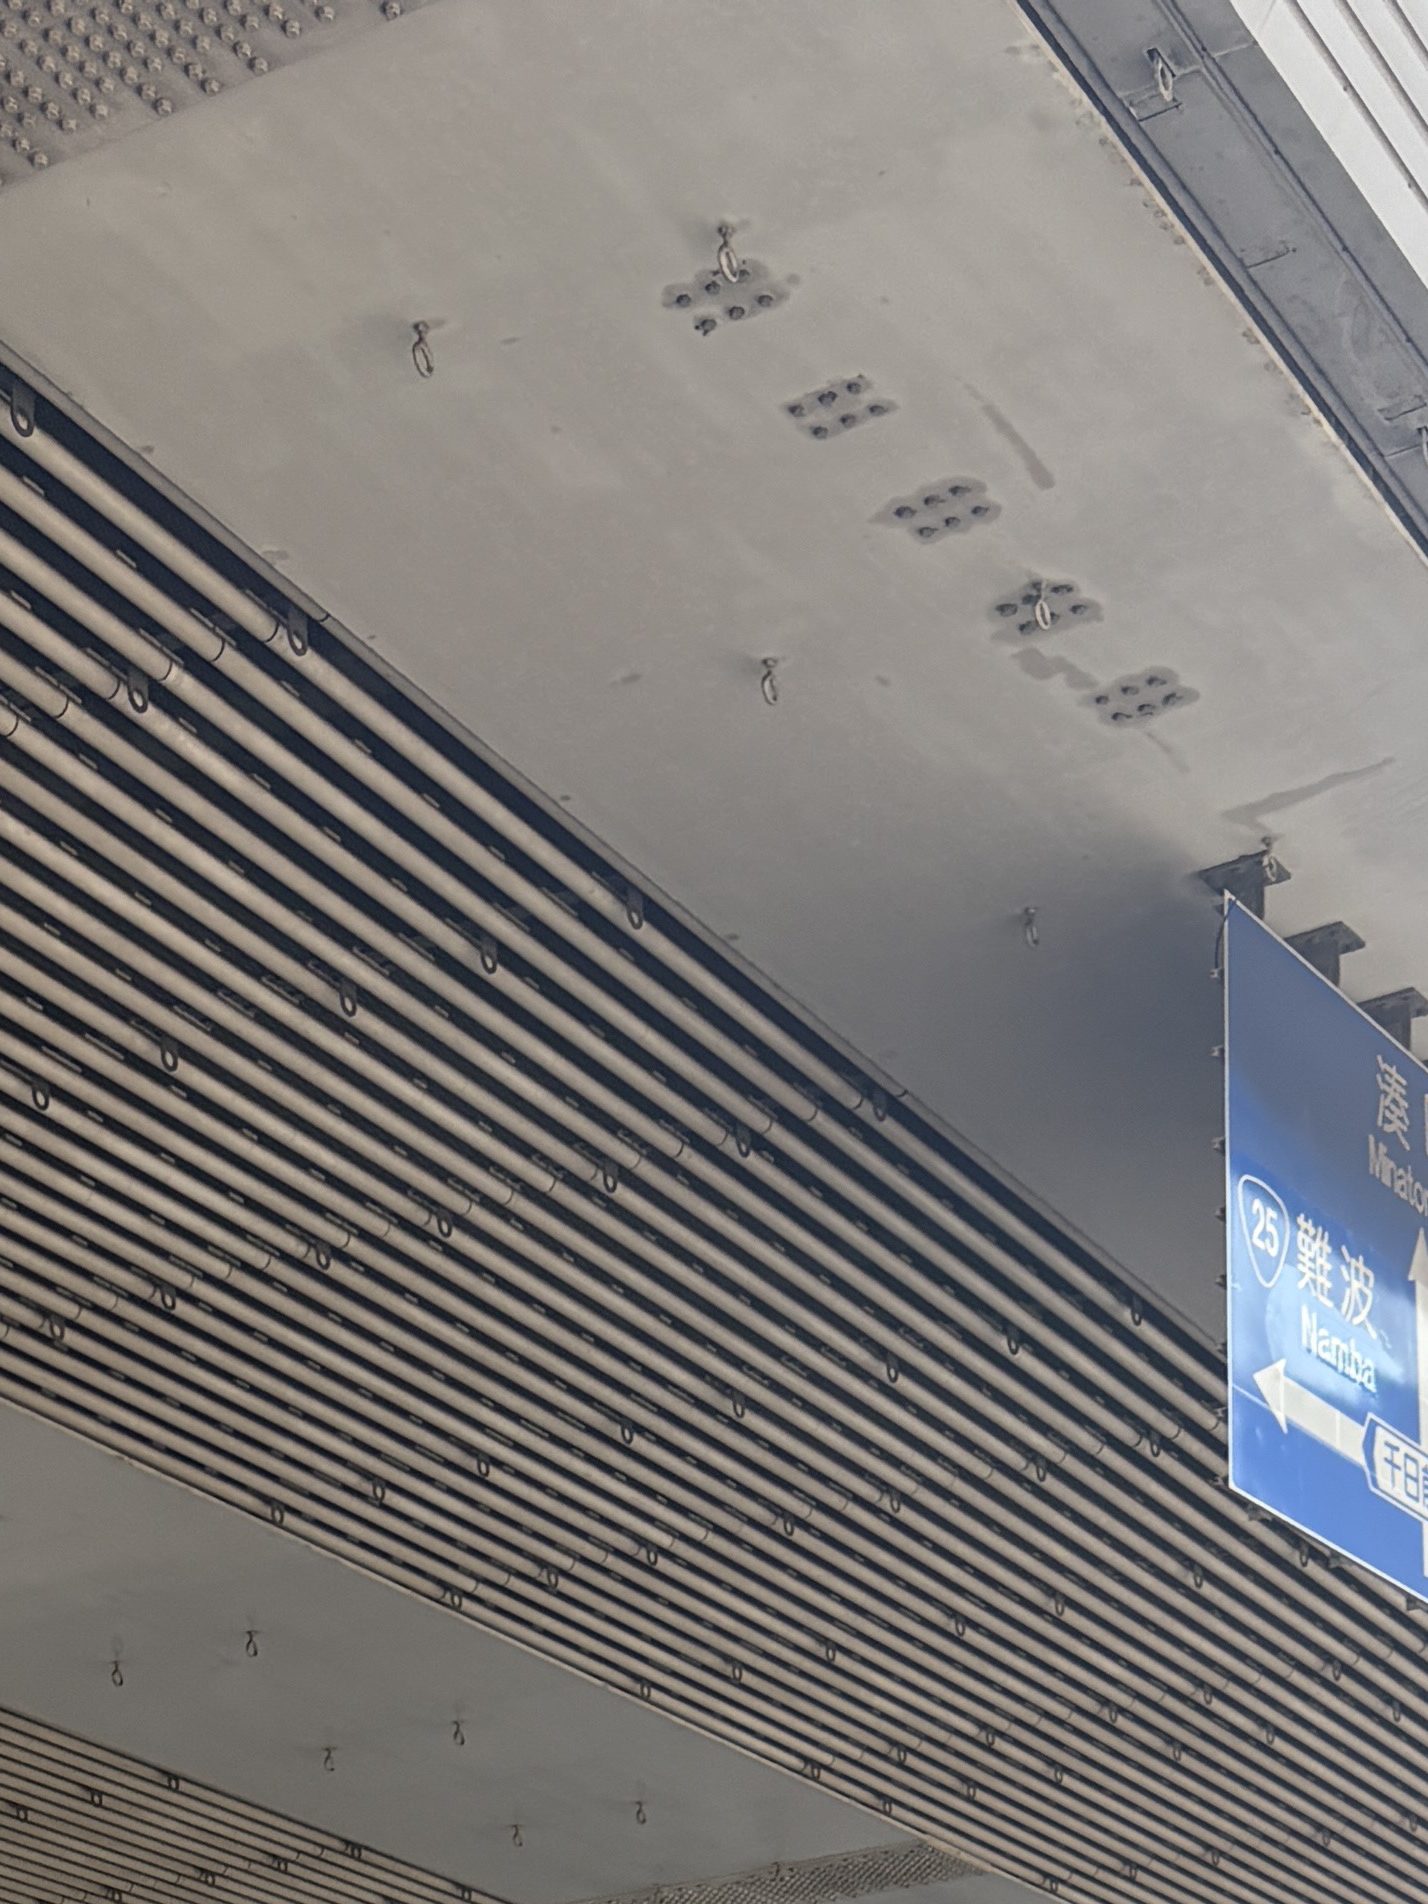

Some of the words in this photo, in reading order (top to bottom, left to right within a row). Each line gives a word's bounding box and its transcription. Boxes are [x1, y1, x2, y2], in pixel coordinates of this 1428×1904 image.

[1251, 1198, 1280, 1258] 25
[1296, 1214, 1376, 1340] 難波
[1300, 1304, 1377, 1393] Namba
